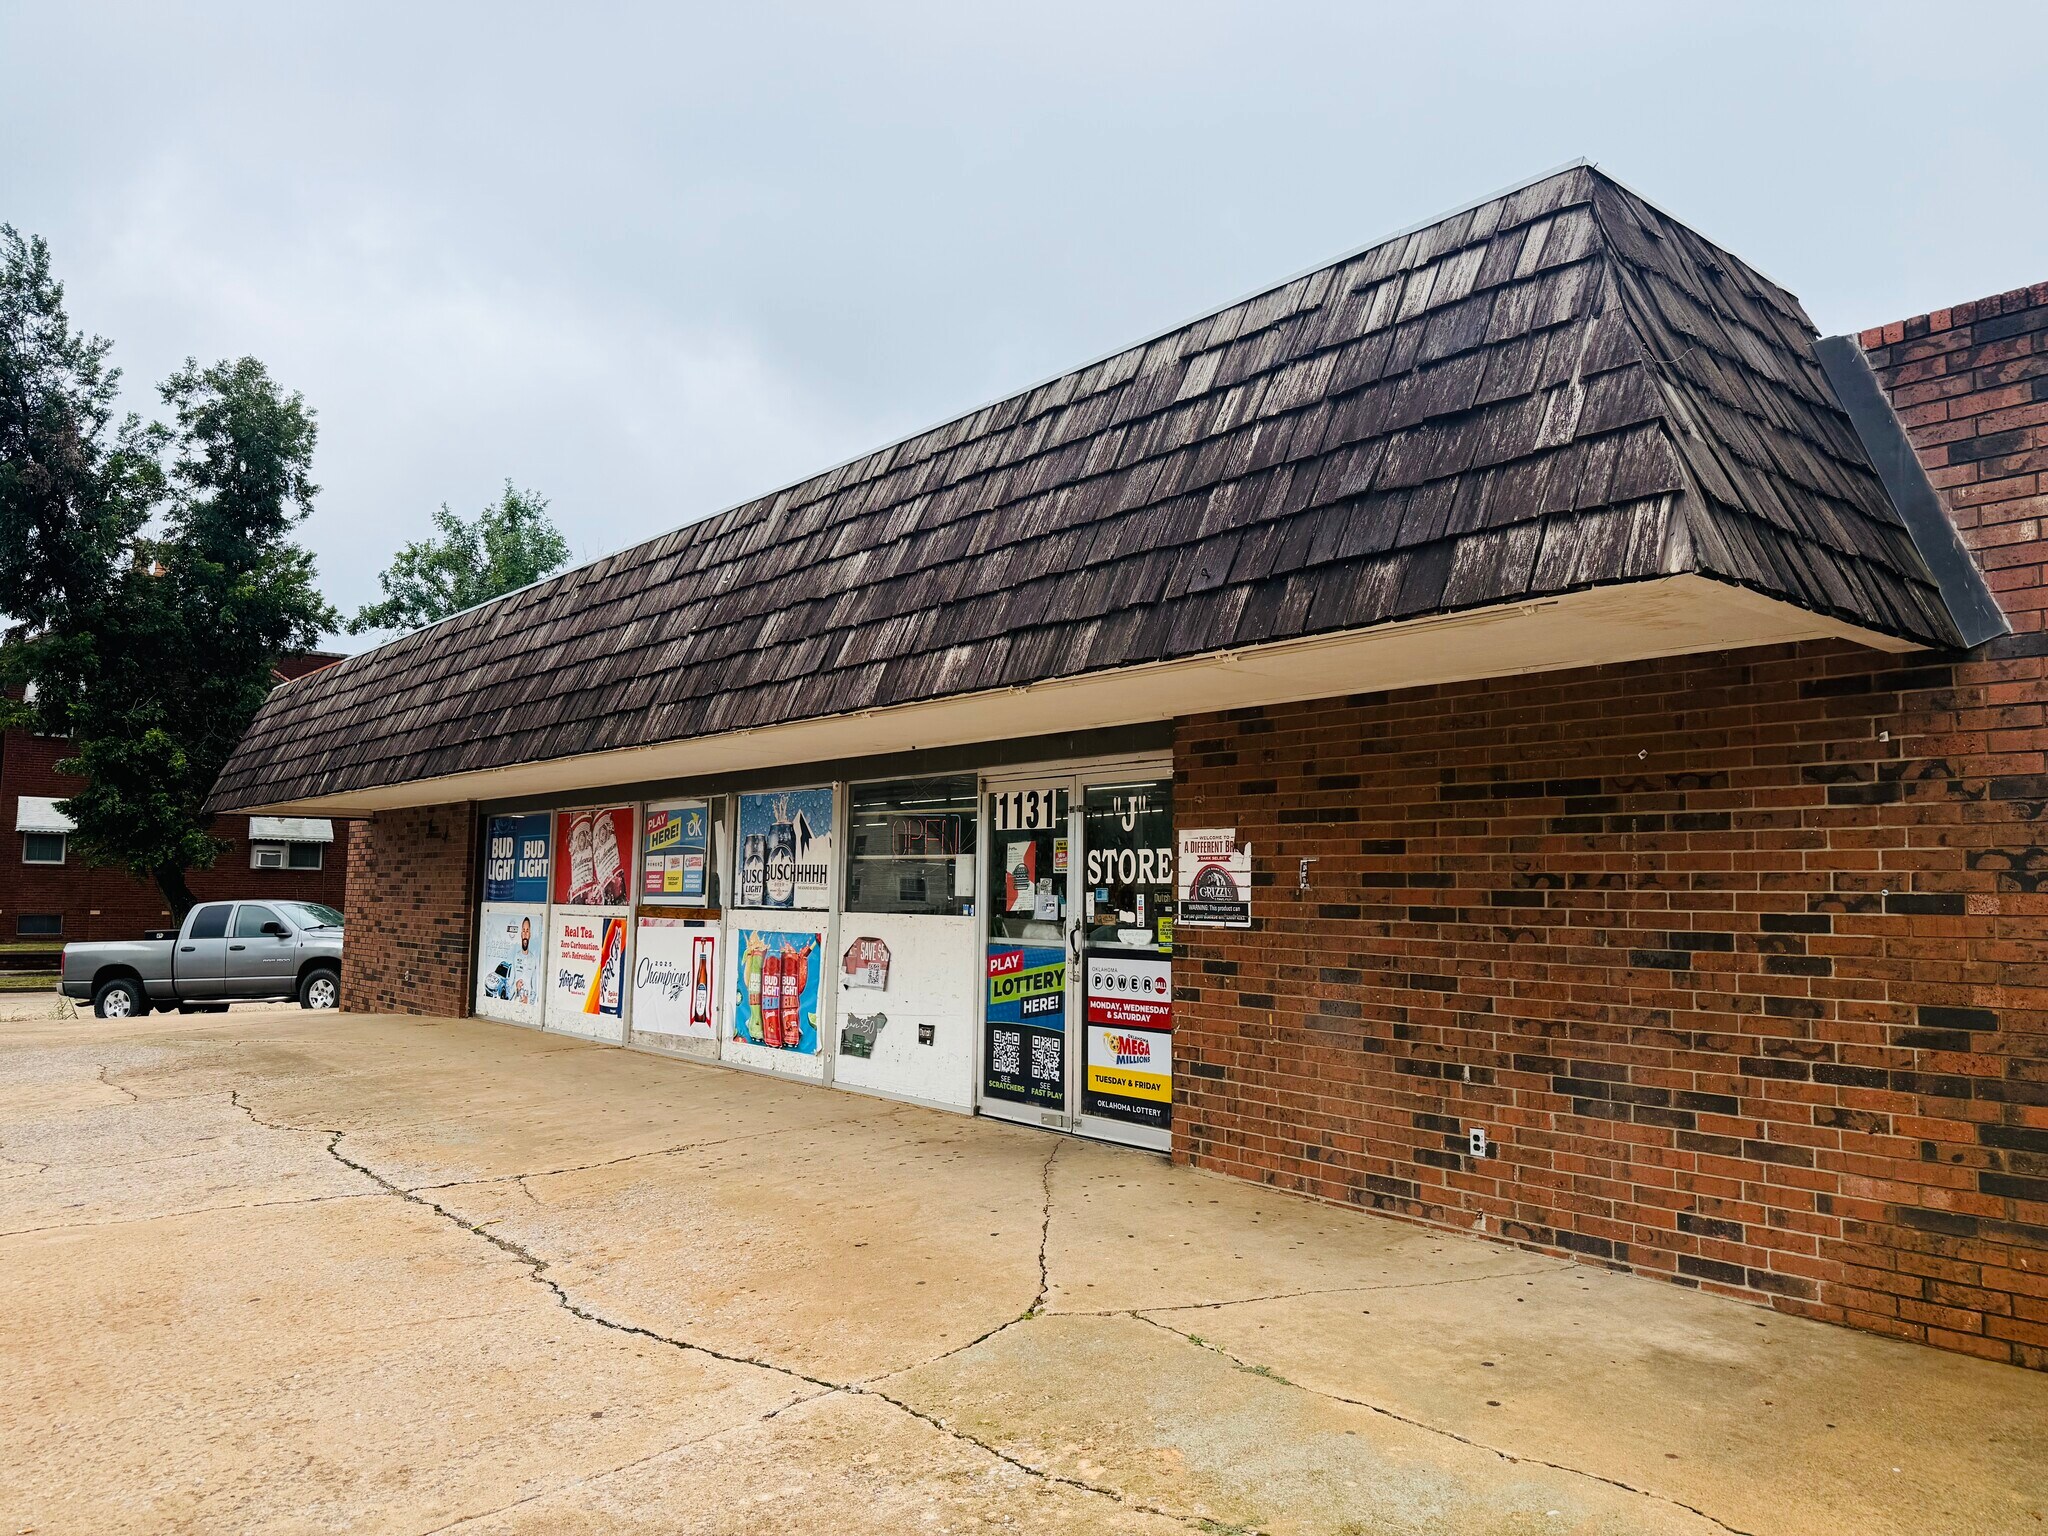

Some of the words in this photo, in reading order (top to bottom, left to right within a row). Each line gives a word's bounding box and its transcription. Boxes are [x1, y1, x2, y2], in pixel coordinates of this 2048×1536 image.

[1000, 790, 1053, 829] 1131
[1114, 795, 1146, 832] "J"
[648, 814, 666, 830] PLAY
[652, 823, 679, 848] HERE!
[892, 819, 958, 855] OPEN
[492, 837, 513, 858] BUD
[524, 840, 545, 858] BUD
[1184, 842, 1188, 853] A
[1190, 841, 1223, 853] DIFFERENT
[488, 859, 515, 881] LIGHT
[519, 859, 548, 877] LIGHT
[1088, 848, 1173, 885] STORE
[1200, 886, 1233, 899] GRIZZLY
[565, 926, 579, 937] Real
[580, 927, 594, 938] Tea.
[561, 940, 570, 948] Zero
[571, 941, 599, 950] Carbonation.
[860, 942, 876, 960] SAVE
[572, 952, 596, 962] Refreshing.
[990, 955, 1019, 972] PLAY
[637, 957, 690, 994] Champions
[765, 976, 778, 986] BUD
[994, 968, 1065, 997] LOTTERY
[763, 986, 779, 996] LIGHT
[1024, 996, 1059, 1014] HERE!
[1090, 1001, 1122, 1011] MONDAY,
[1123, 1003, 1169, 1014] WEDNESDAY
[1113, 1011, 1151, 1022] SATURDAY
[1118, 1035, 1150, 1055] MEGA
[1128, 1034, 1148, 1042] OKLAHOMA
[1116, 1054, 1150, 1065] MILLIONS
[989, 1080, 1025, 1093] SCRATCHERS
[1001, 1075, 1011, 1083] SEE
[1040, 1082, 1051, 1090] SEE
[1095, 1075, 1126, 1085] TUESDAY
[1135, 1081, 1161, 1091] FRIDAY
[1031, 1088, 1046, 1096] FAST
[1047, 1091, 1063, 1099] PLAY
[1097, 1100, 1131, 1112] OKLAHOMA
[1133, 1105, 1161, 1117] LOTTERY
